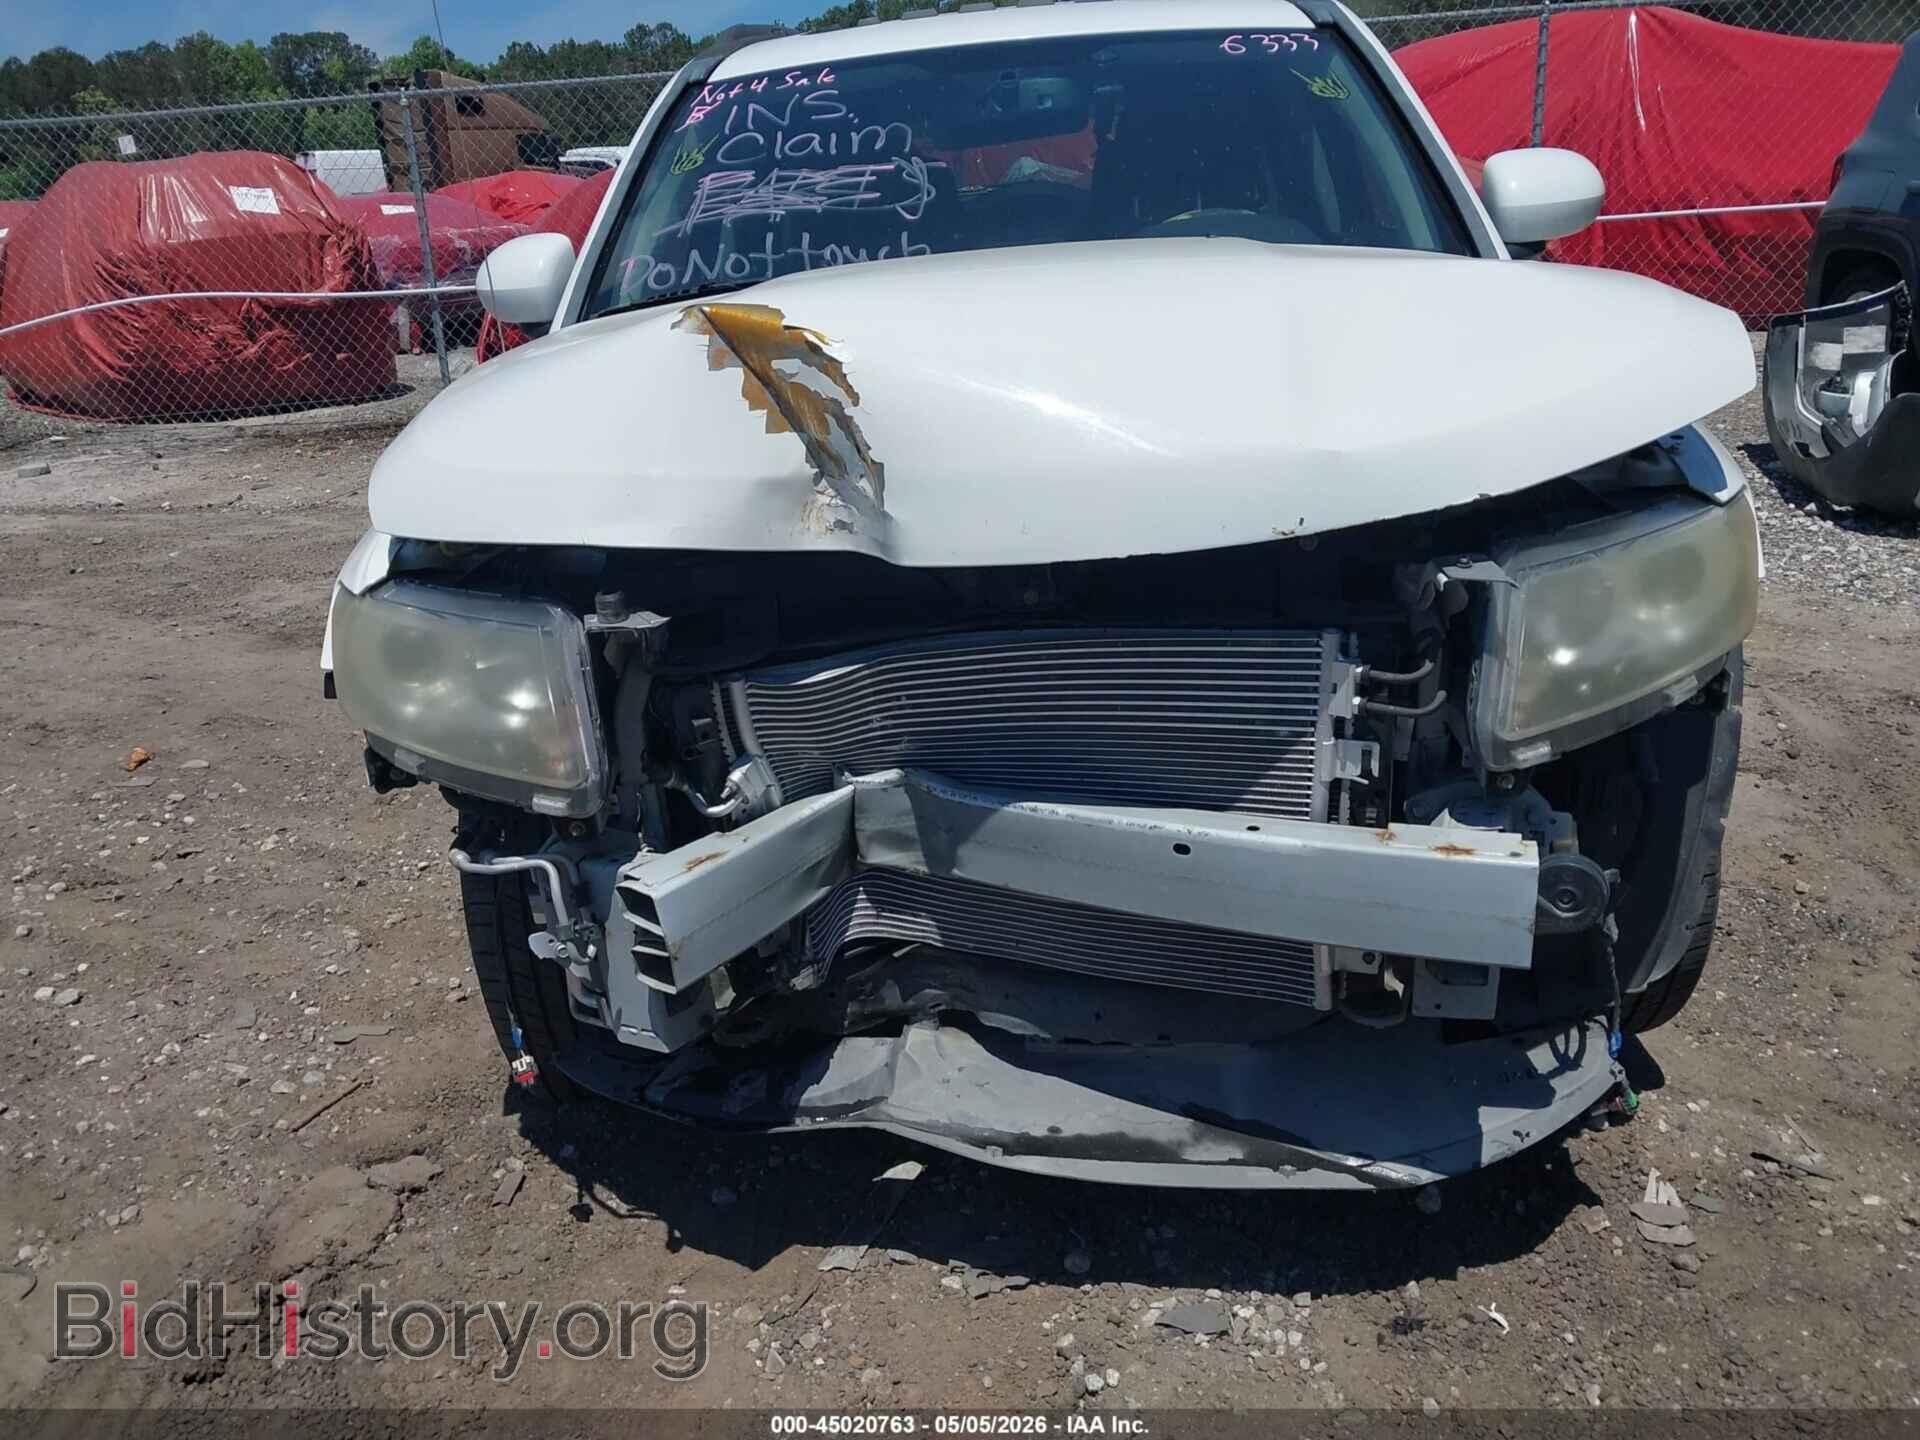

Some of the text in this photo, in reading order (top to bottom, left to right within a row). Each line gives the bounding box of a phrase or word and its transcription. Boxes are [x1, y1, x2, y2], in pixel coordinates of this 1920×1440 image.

[690, 83, 745, 108] Not
[750, 77, 769, 93] 4
[716, 122, 912, 164] Claim
